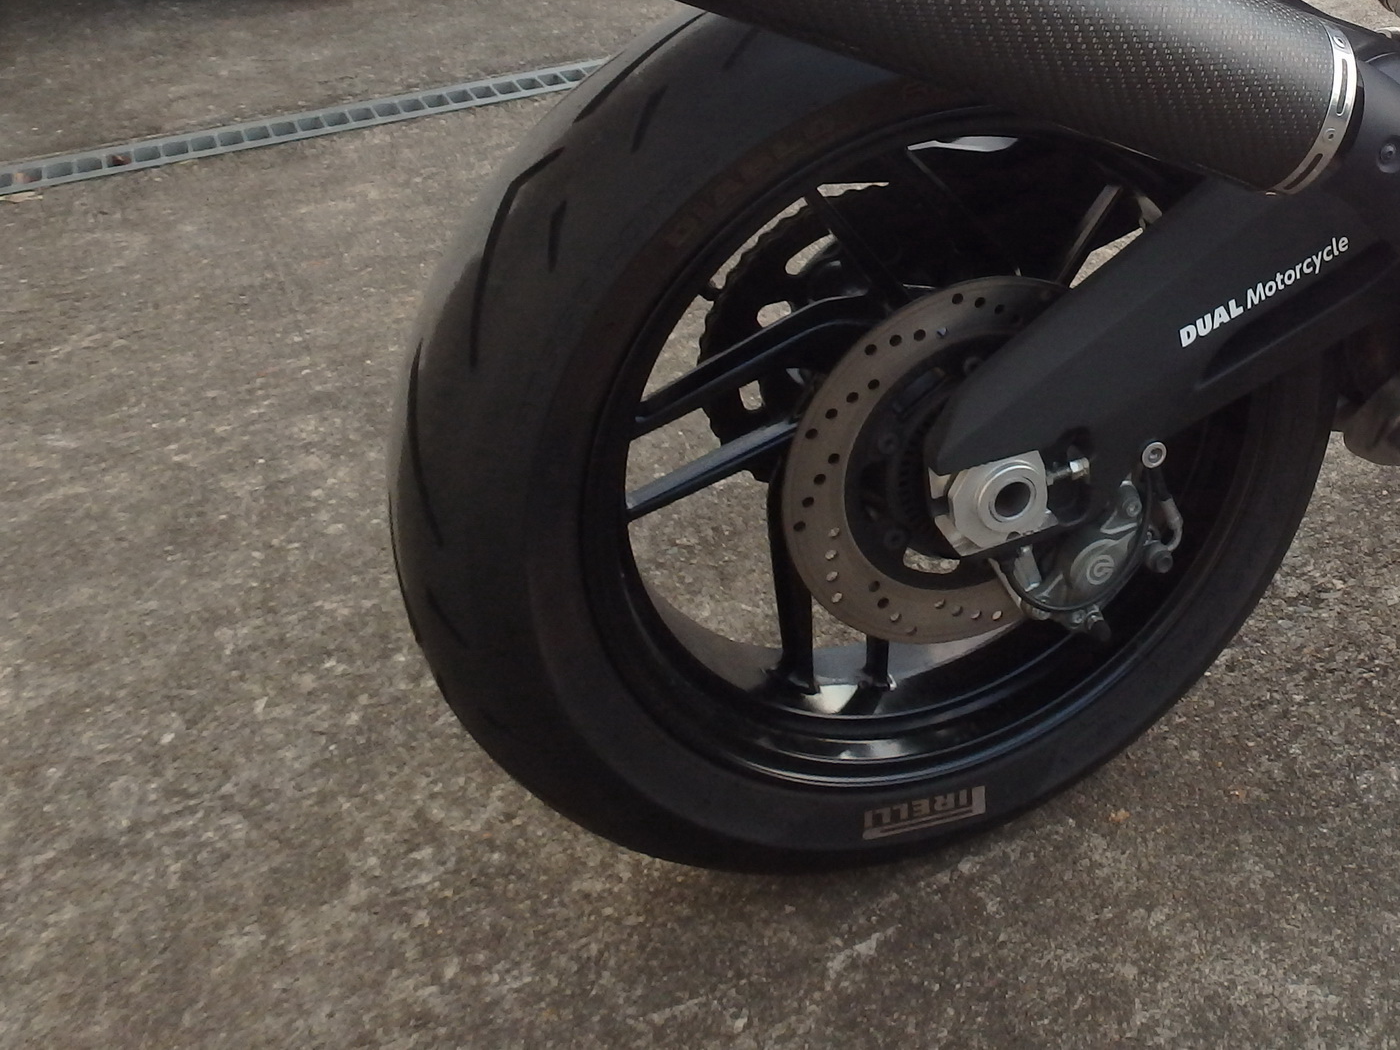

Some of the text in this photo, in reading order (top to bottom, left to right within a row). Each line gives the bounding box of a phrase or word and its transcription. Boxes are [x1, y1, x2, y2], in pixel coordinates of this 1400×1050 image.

[1178, 235, 1349, 348] DUAL Motorcycle
[862, 785, 986, 841] PIRELLI
